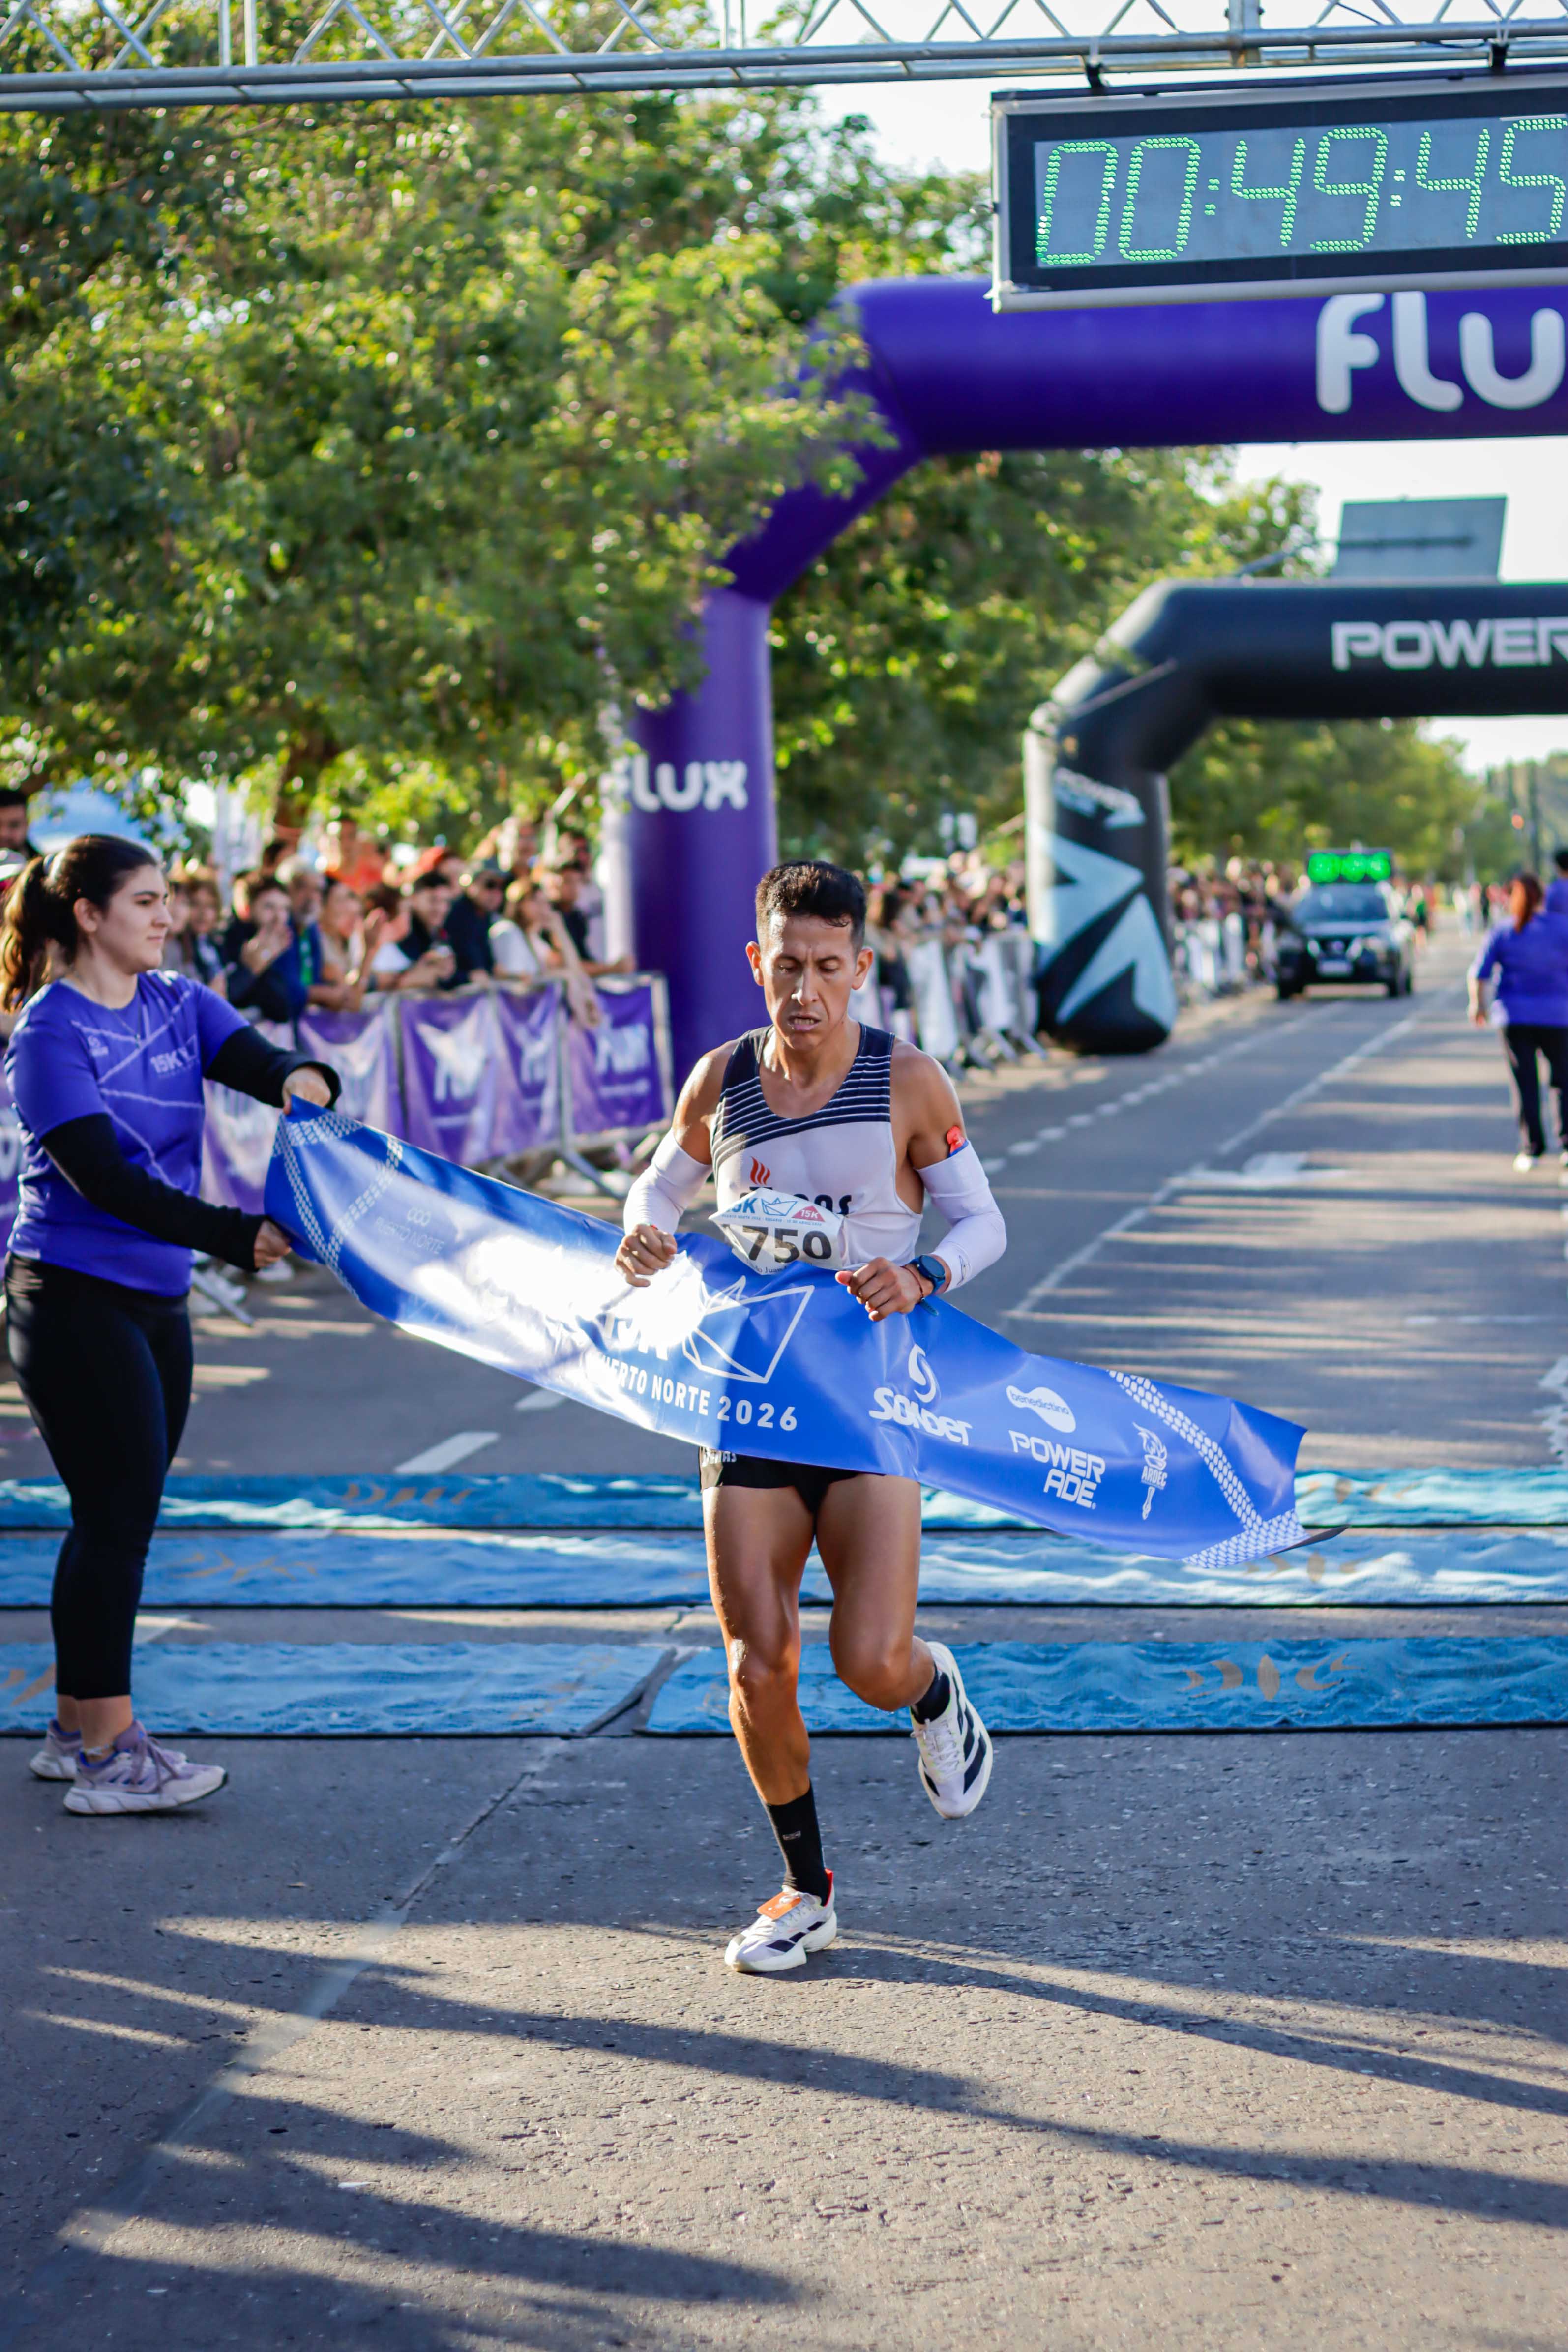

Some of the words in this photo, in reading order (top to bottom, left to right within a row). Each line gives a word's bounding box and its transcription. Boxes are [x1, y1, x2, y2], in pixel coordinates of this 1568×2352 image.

[1036, 118, 1568, 265] 00:49:45
[1331, 617, 1568, 672] POWER
[800, 1209, 819, 1219] 15K
[409, 1231, 445, 1255] NORTE
[651, 1375, 711, 1416] NORTE
[716, 1395, 798, 1431] 2026
[1008, 1429, 1106, 1484] POWER
[1141, 1465, 1168, 1487] ARDEC
